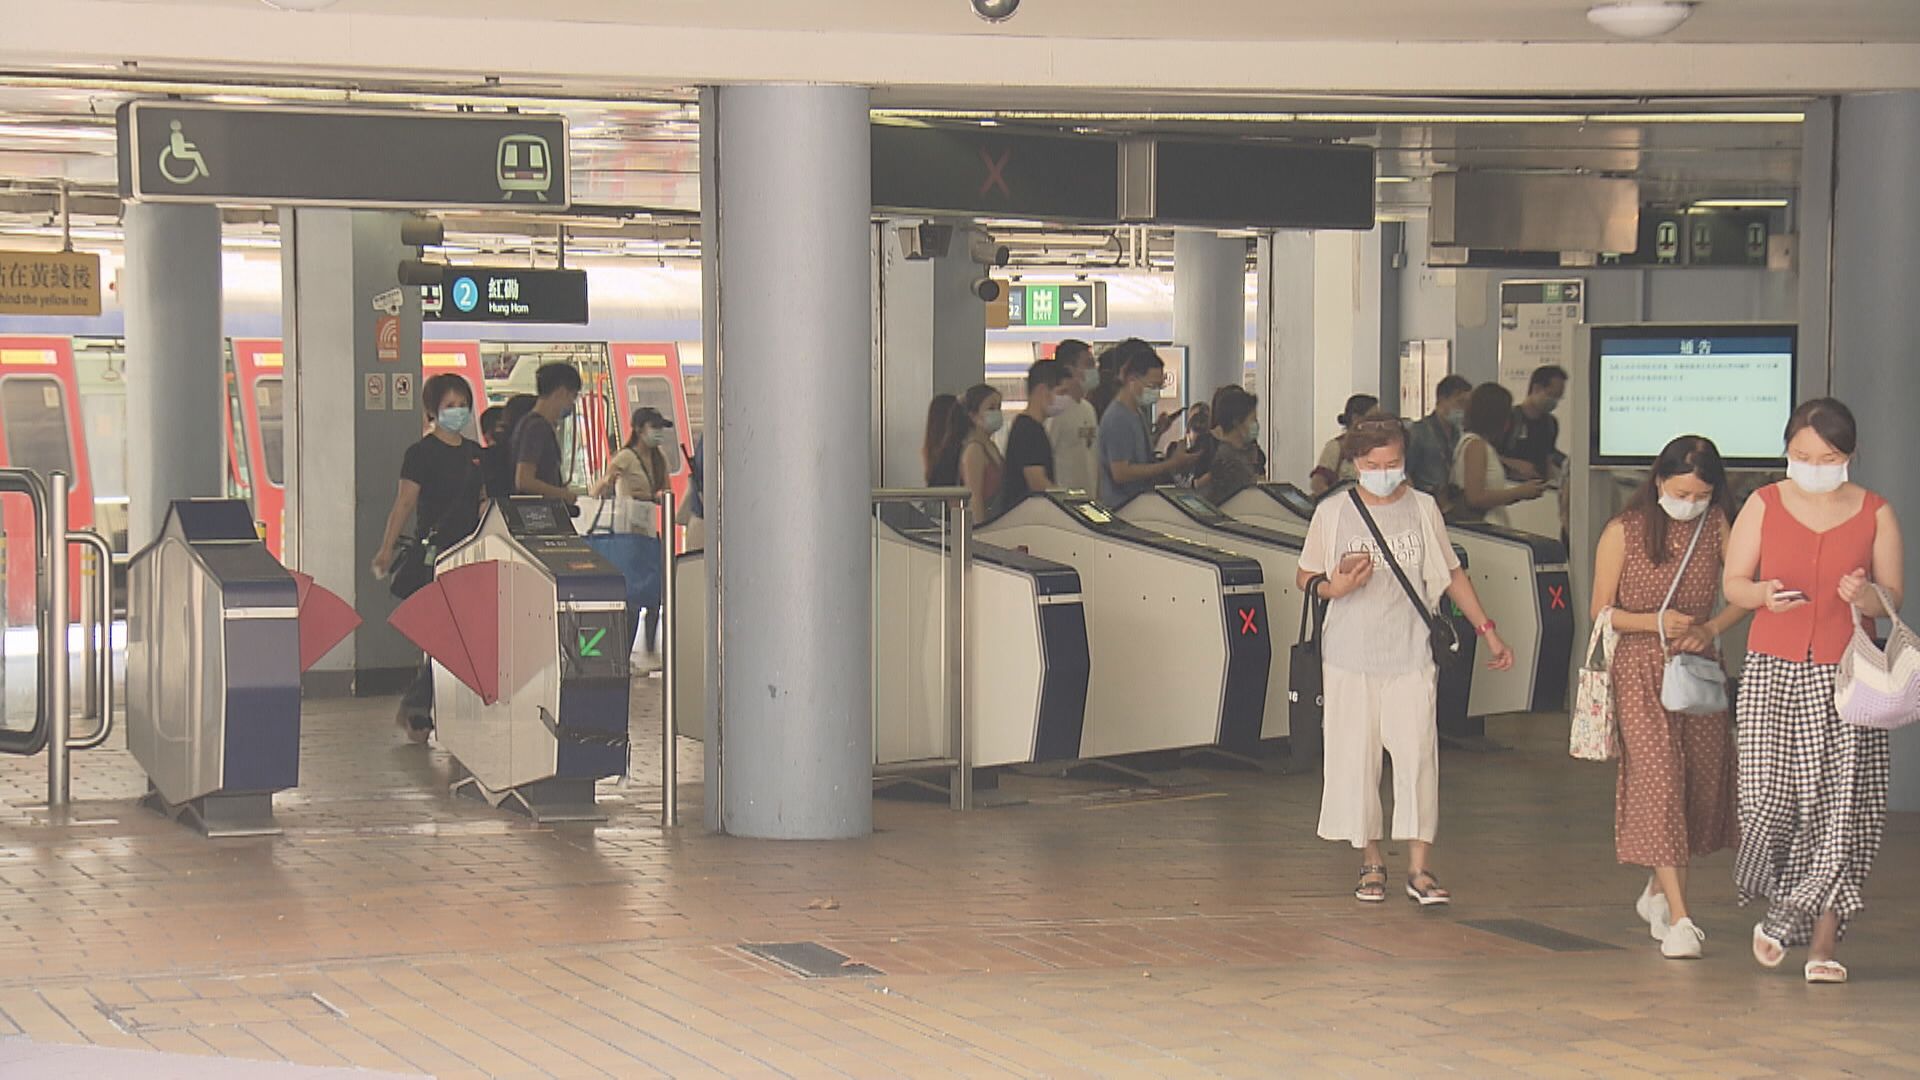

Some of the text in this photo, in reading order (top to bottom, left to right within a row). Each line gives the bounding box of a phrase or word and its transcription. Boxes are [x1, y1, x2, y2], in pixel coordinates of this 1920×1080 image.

[22, 294, 37, 305] the
[40, 294, 70, 307] yellow
[460, 283, 471, 306] 2
[488, 302, 530, 316] Hung Hom
